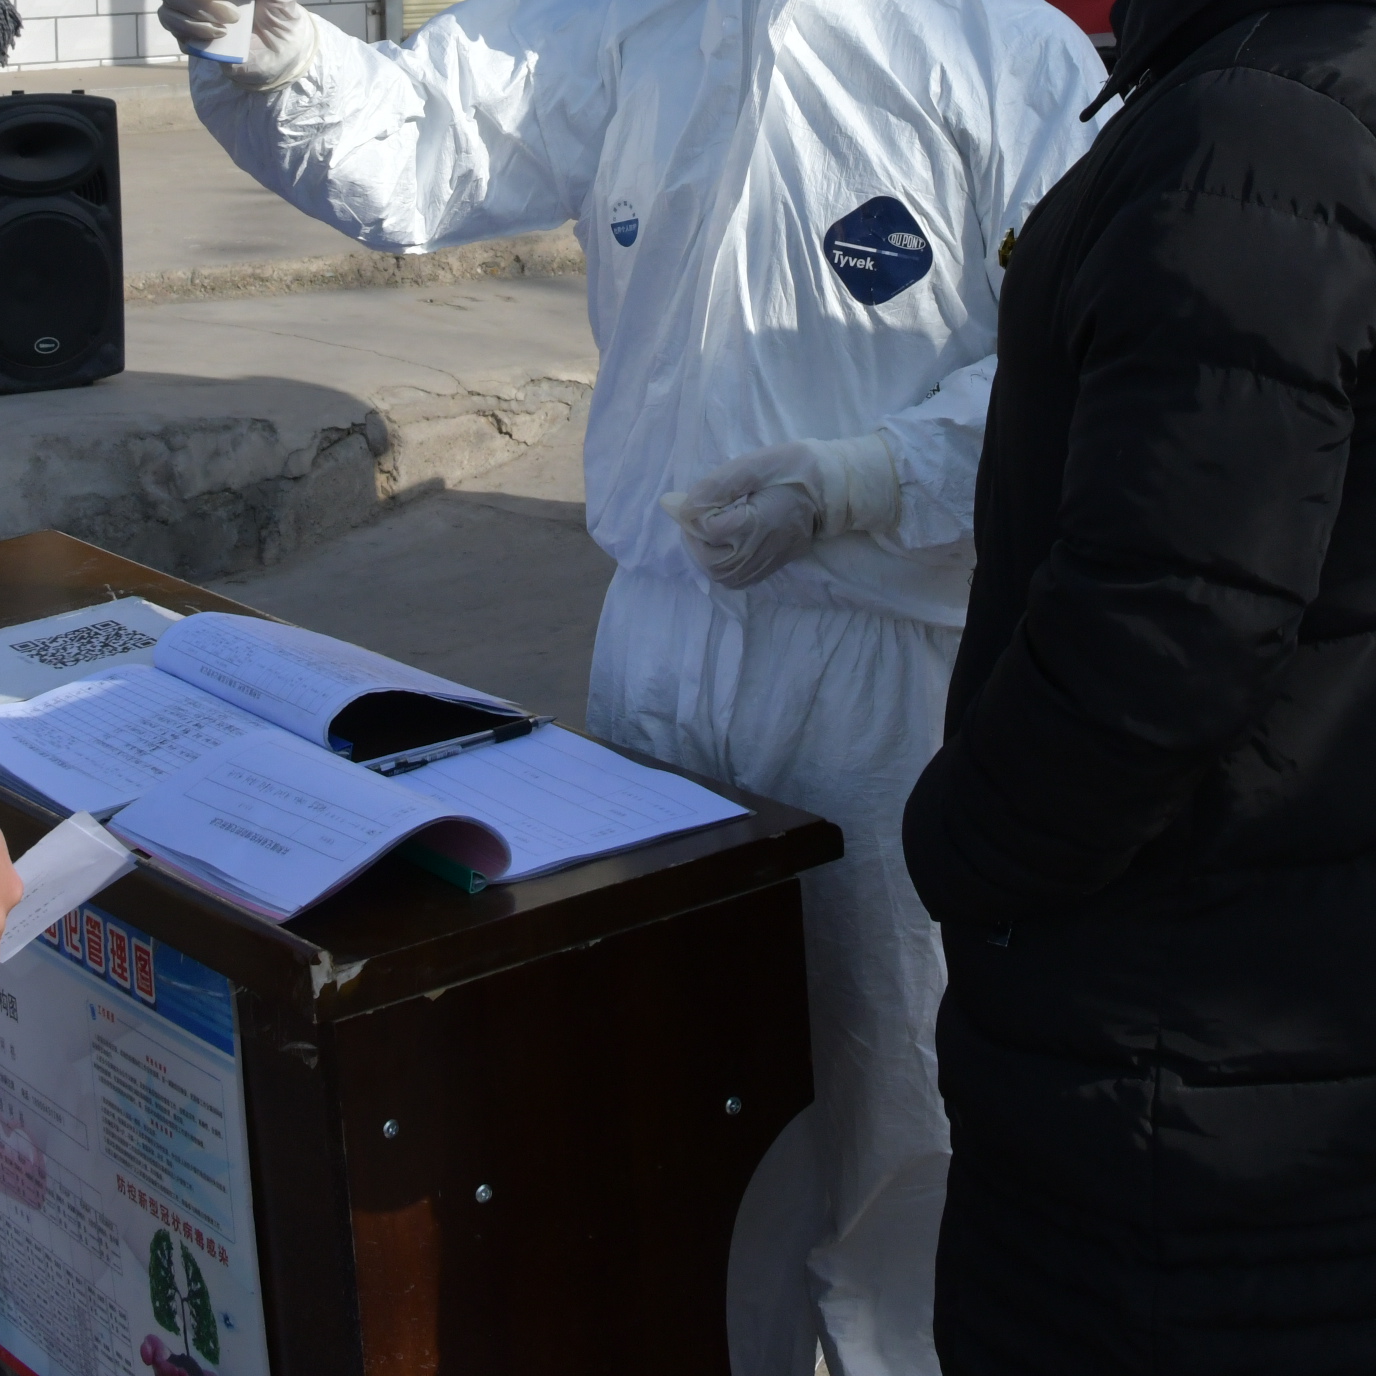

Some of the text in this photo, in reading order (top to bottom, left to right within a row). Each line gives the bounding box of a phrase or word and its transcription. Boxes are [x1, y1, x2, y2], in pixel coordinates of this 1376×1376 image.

[832, 249, 875, 271] Tyvek
[116, 1173, 230, 1267] 防控新型冠状病毒感染
